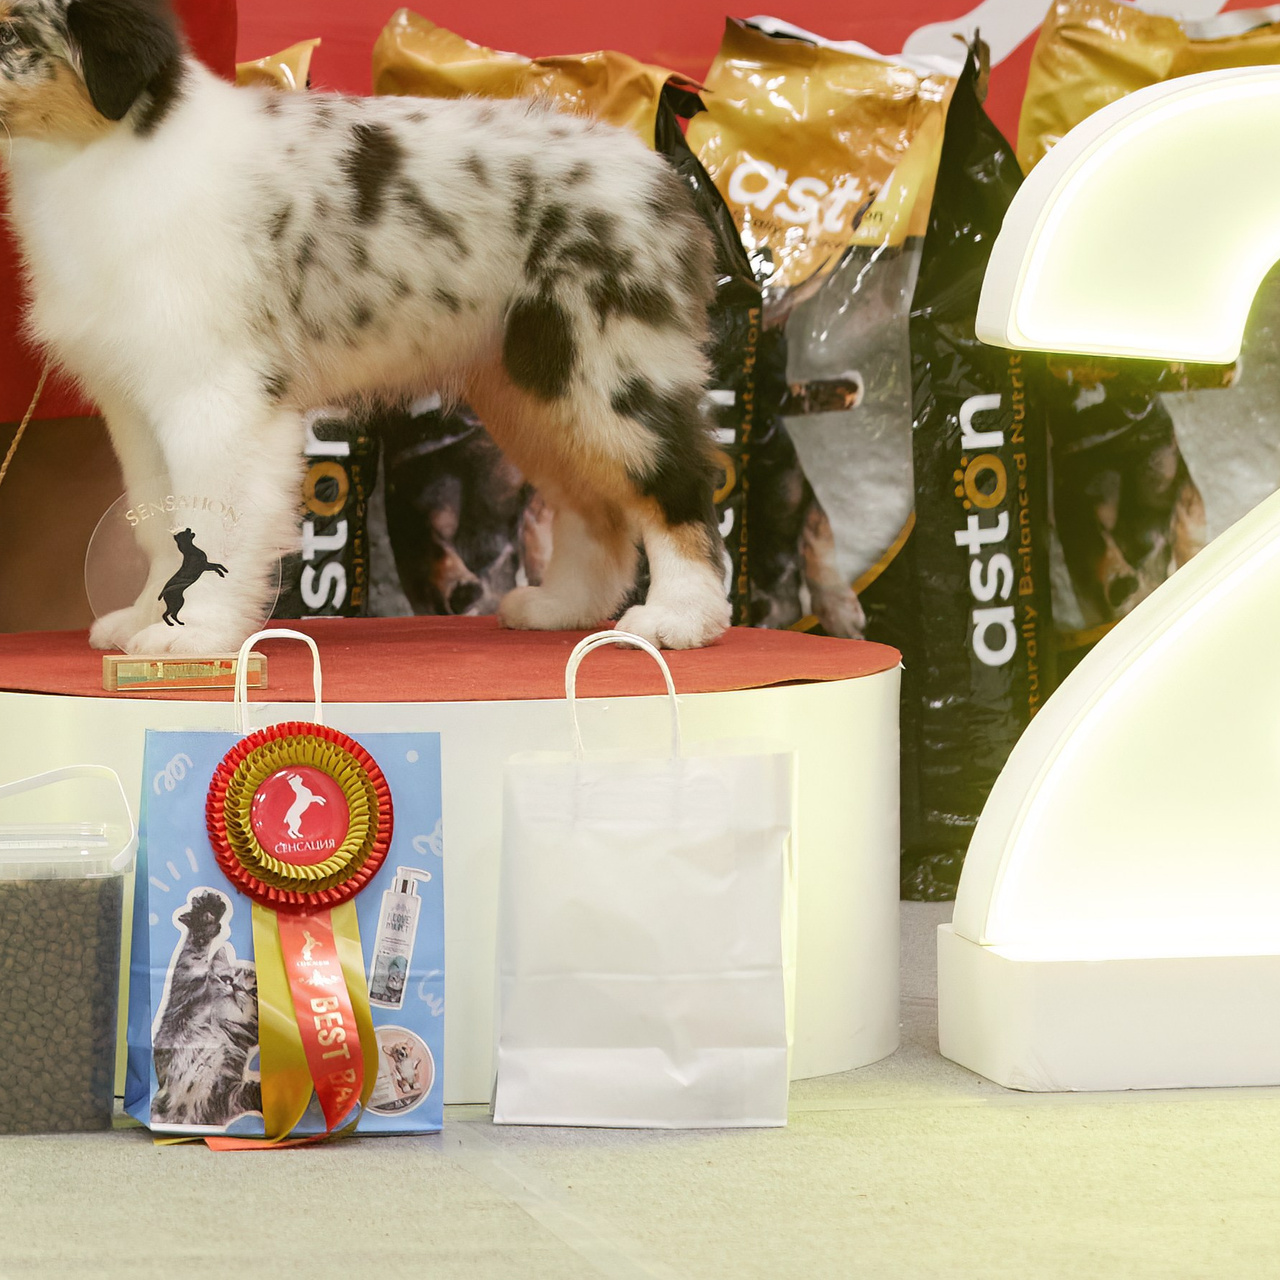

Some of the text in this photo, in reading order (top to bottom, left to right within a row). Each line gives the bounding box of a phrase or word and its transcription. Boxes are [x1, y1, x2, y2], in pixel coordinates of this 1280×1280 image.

[728, 160, 863, 233] ast
[124, 494, 244, 527] SENSATION
[1008, 353, 1041, 720] turally Balanced Nutrit
[274, 838, 336, 854] СЕНСАЦИЯ
[310, 995, 351, 1060] BEST
